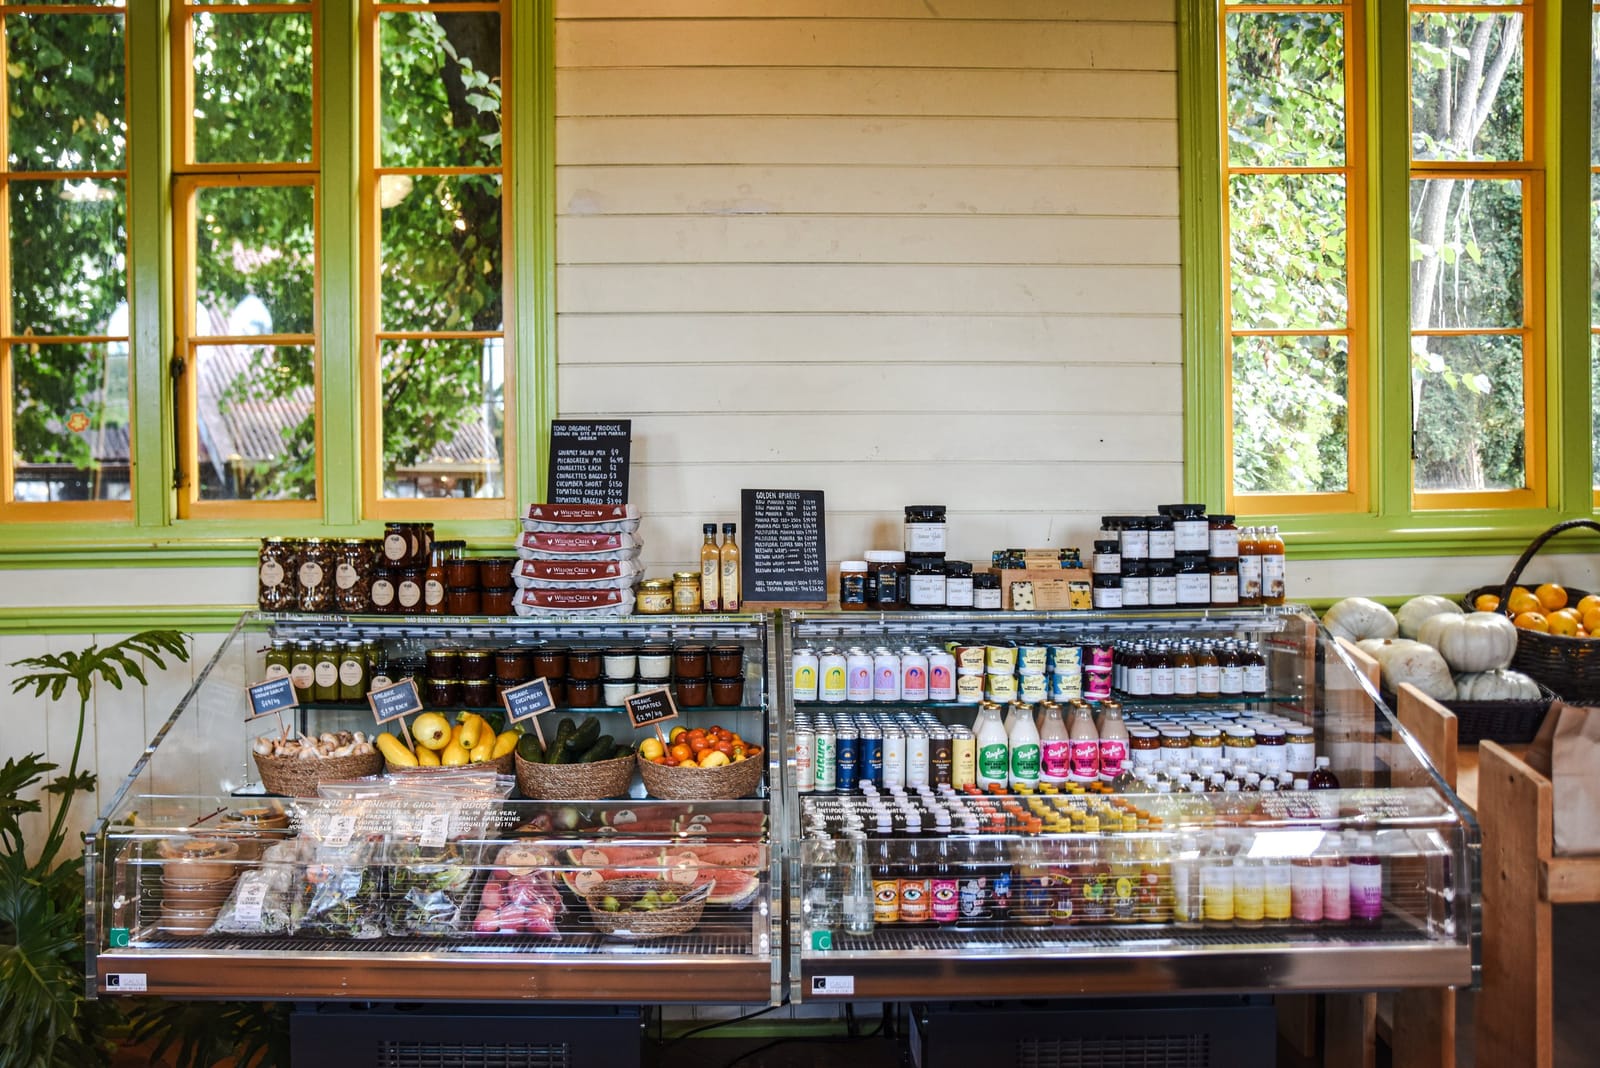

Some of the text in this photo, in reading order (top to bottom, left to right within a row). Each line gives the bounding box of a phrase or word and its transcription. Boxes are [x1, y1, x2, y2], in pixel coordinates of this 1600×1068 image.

[756, 491, 776, 499] GOLDEN
[515, 691, 543, 704] CUCUMBERS
[631, 697, 651, 706] ORGANIC
[637, 701, 661, 710] TOMATOES
[816, 738, 825, 780] Future
